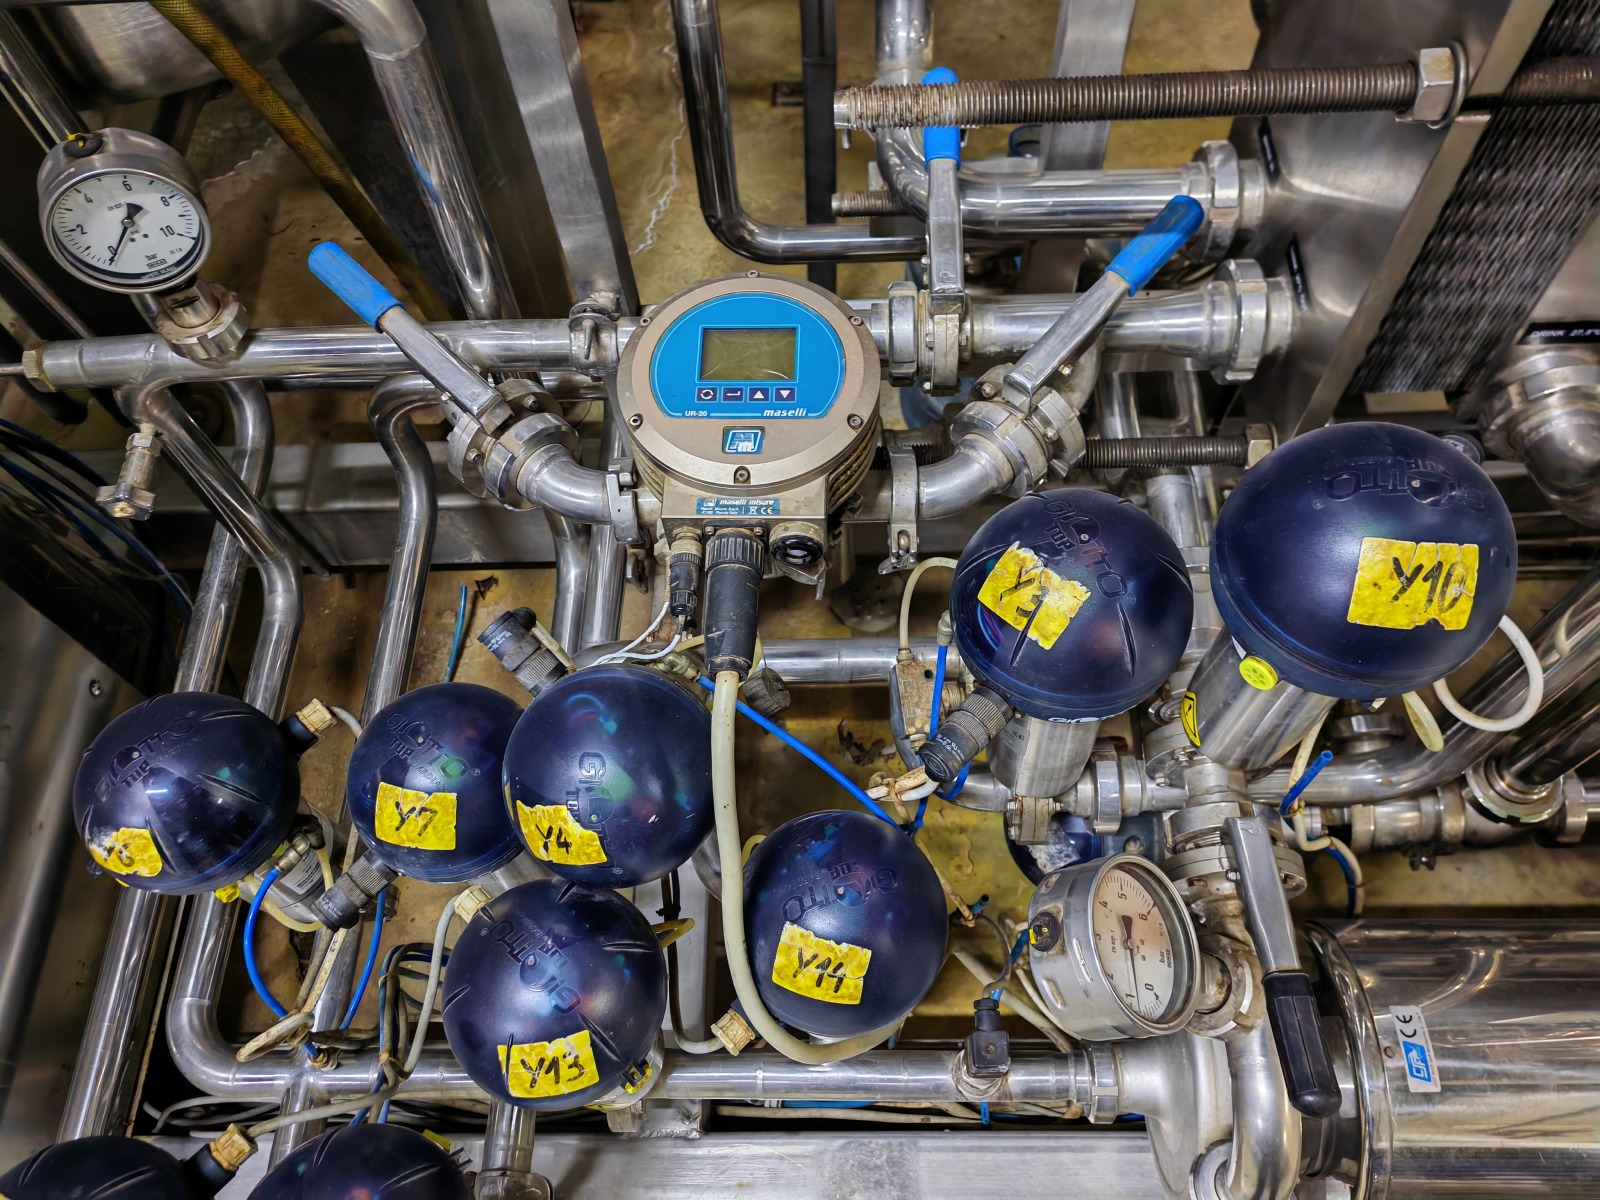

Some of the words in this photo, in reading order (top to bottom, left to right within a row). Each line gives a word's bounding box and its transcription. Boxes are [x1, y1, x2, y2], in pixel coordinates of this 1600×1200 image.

[122, 181, 132, 191] 6
[83, 193, 94, 203] 4
[160, 196, 170, 207] 8
[76, 224, 88, 235] 2
[160, 225, 176, 238] 10
[107, 245, 116, 255] 0
[763, 407, 808, 417] maselli
[1391, 556, 1468, 614] Y10
[394, 800, 438, 837] Y7
[535, 822, 573, 855] Y4
[1117, 891, 1127, 900] 5
[1098, 900, 1109, 909] 4
[1138, 913, 1149, 922] 6
[792, 946, 848, 994] Y14
[1106, 972, 1114, 981] 2
[1144, 983, 1155, 992] 0
[1395, 1014, 1417, 1039] CE
[519, 1050, 587, 1090] Y13
